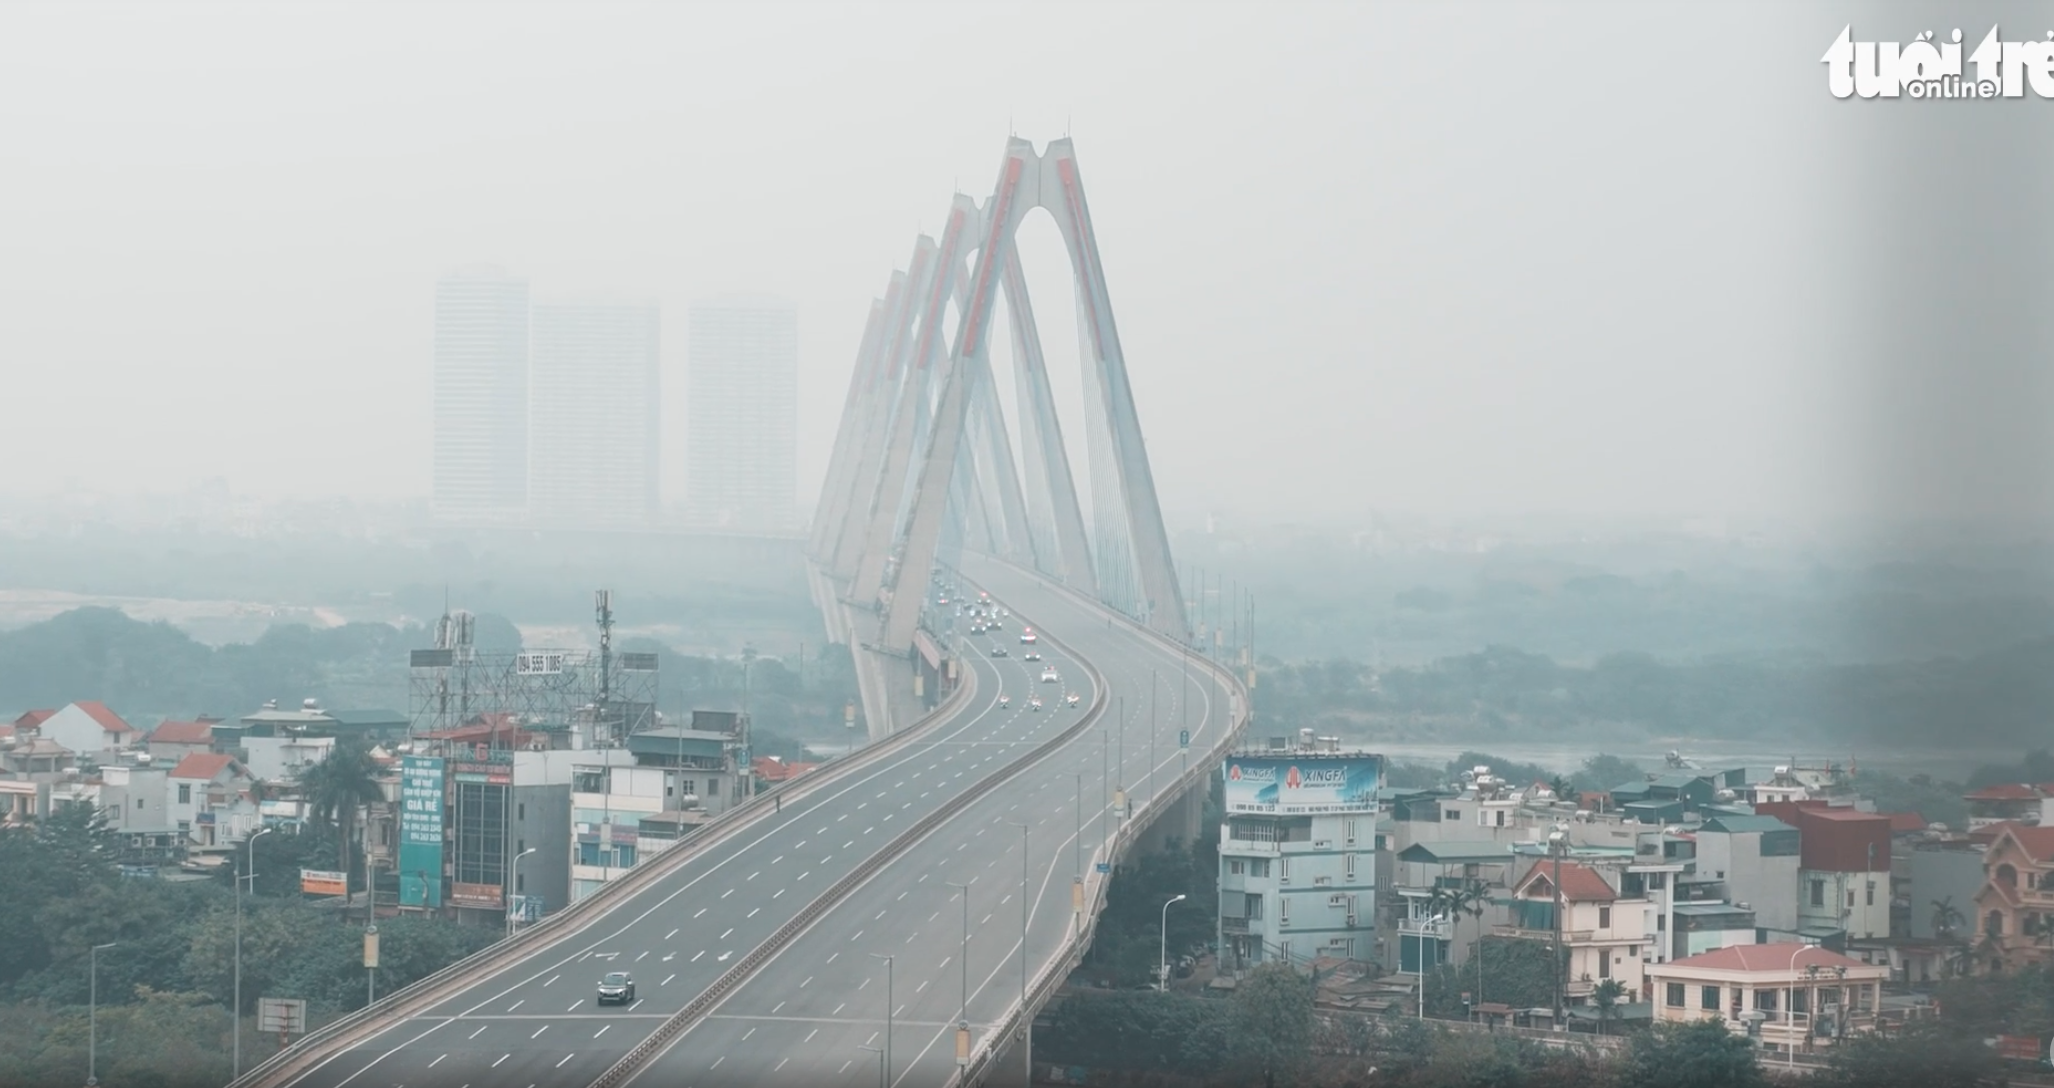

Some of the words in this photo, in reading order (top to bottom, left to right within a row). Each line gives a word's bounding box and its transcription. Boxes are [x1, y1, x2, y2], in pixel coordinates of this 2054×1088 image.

[532, 655, 544, 672] 555
[1304, 770, 1346, 782] XINGFA
[407, 798, 423, 811] GIÁ
